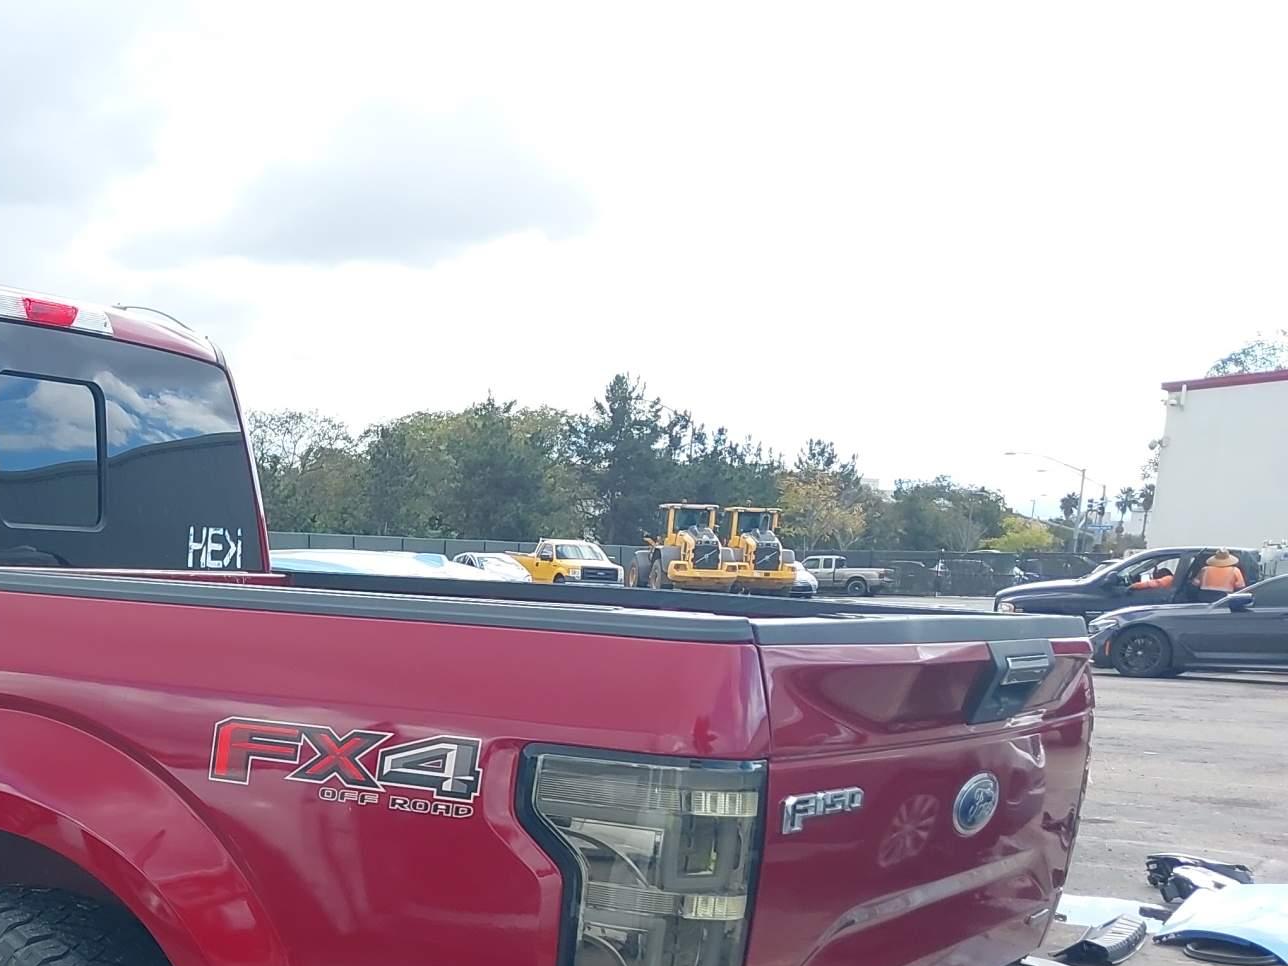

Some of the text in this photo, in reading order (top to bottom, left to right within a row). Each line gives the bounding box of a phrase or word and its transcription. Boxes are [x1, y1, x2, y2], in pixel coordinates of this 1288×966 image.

[209, 716, 482, 802] FX4
[319, 786, 474, 819] OFF ROAD
